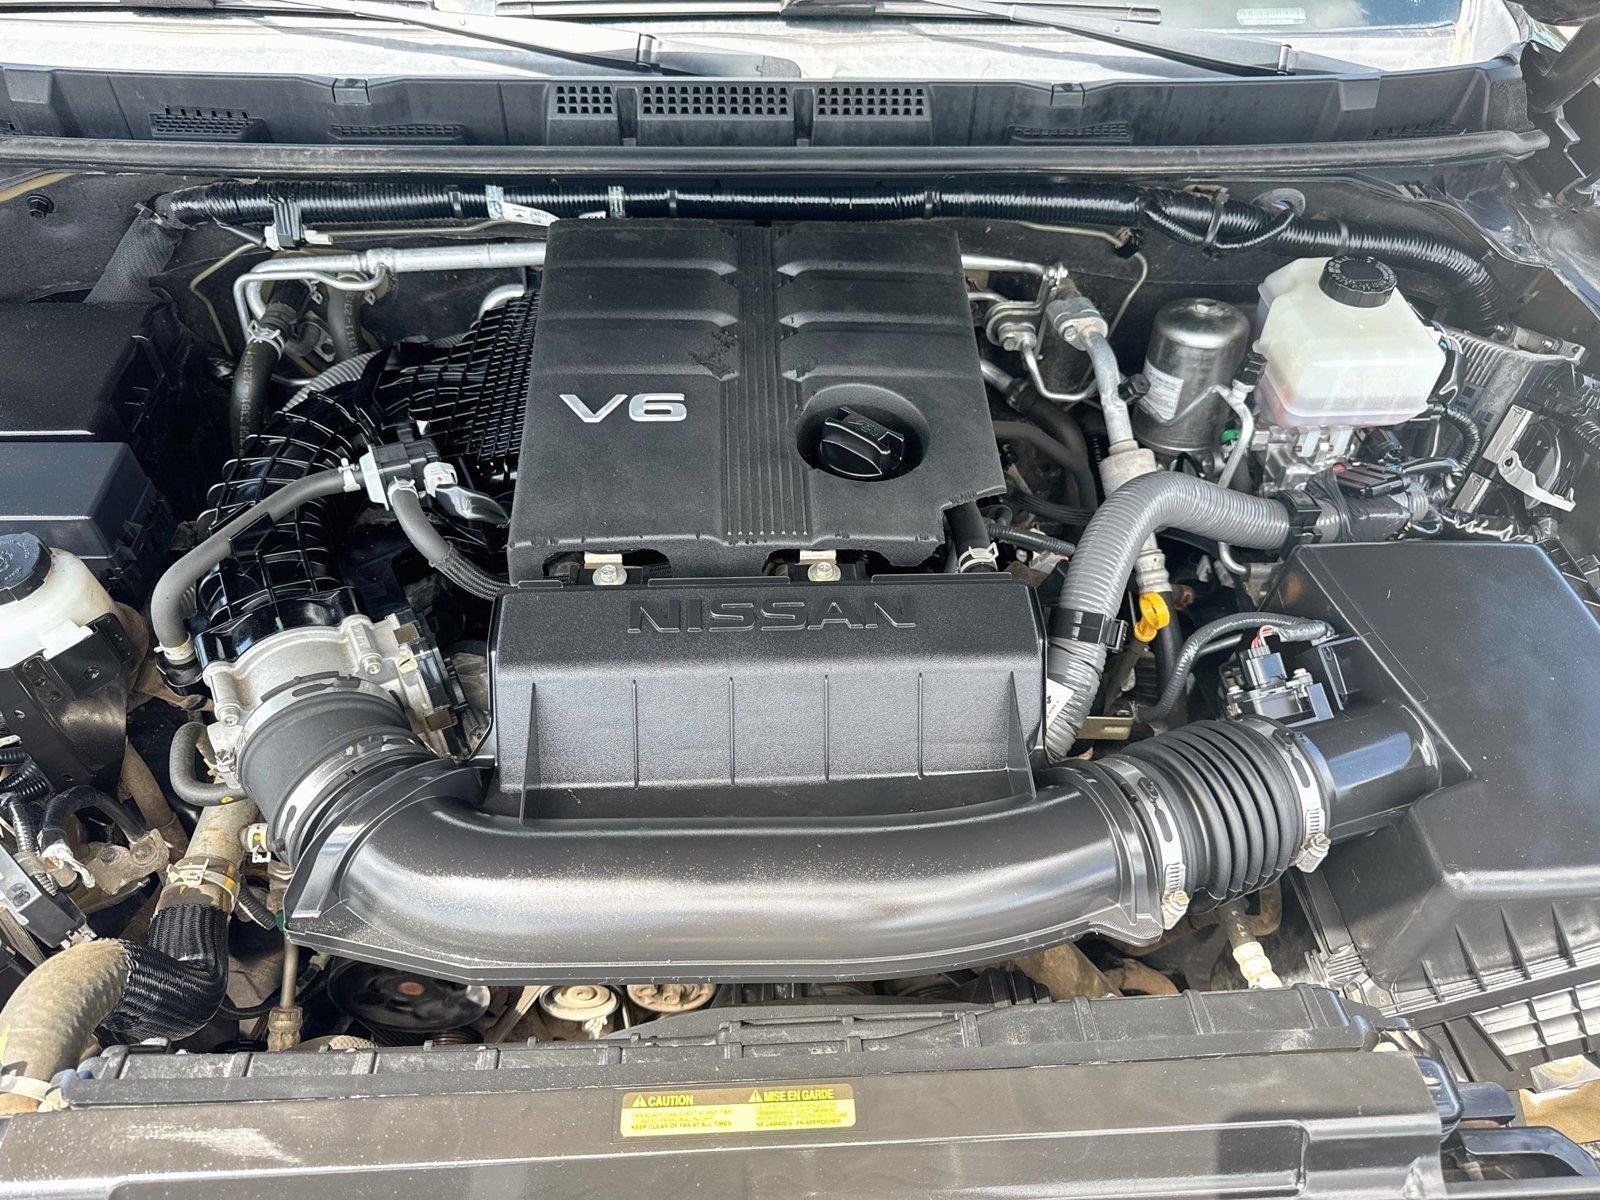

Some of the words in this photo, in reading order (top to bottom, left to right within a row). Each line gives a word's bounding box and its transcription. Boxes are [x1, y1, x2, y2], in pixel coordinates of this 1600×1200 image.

[559, 393, 687, 423] V6
[627, 597, 917, 633] NISSAN
[648, 1095, 694, 1107] CAUTION
[763, 1091, 787, 1102] MISE
[787, 1090, 800, 1101] EN
[801, 1089, 834, 1100] GARDE
